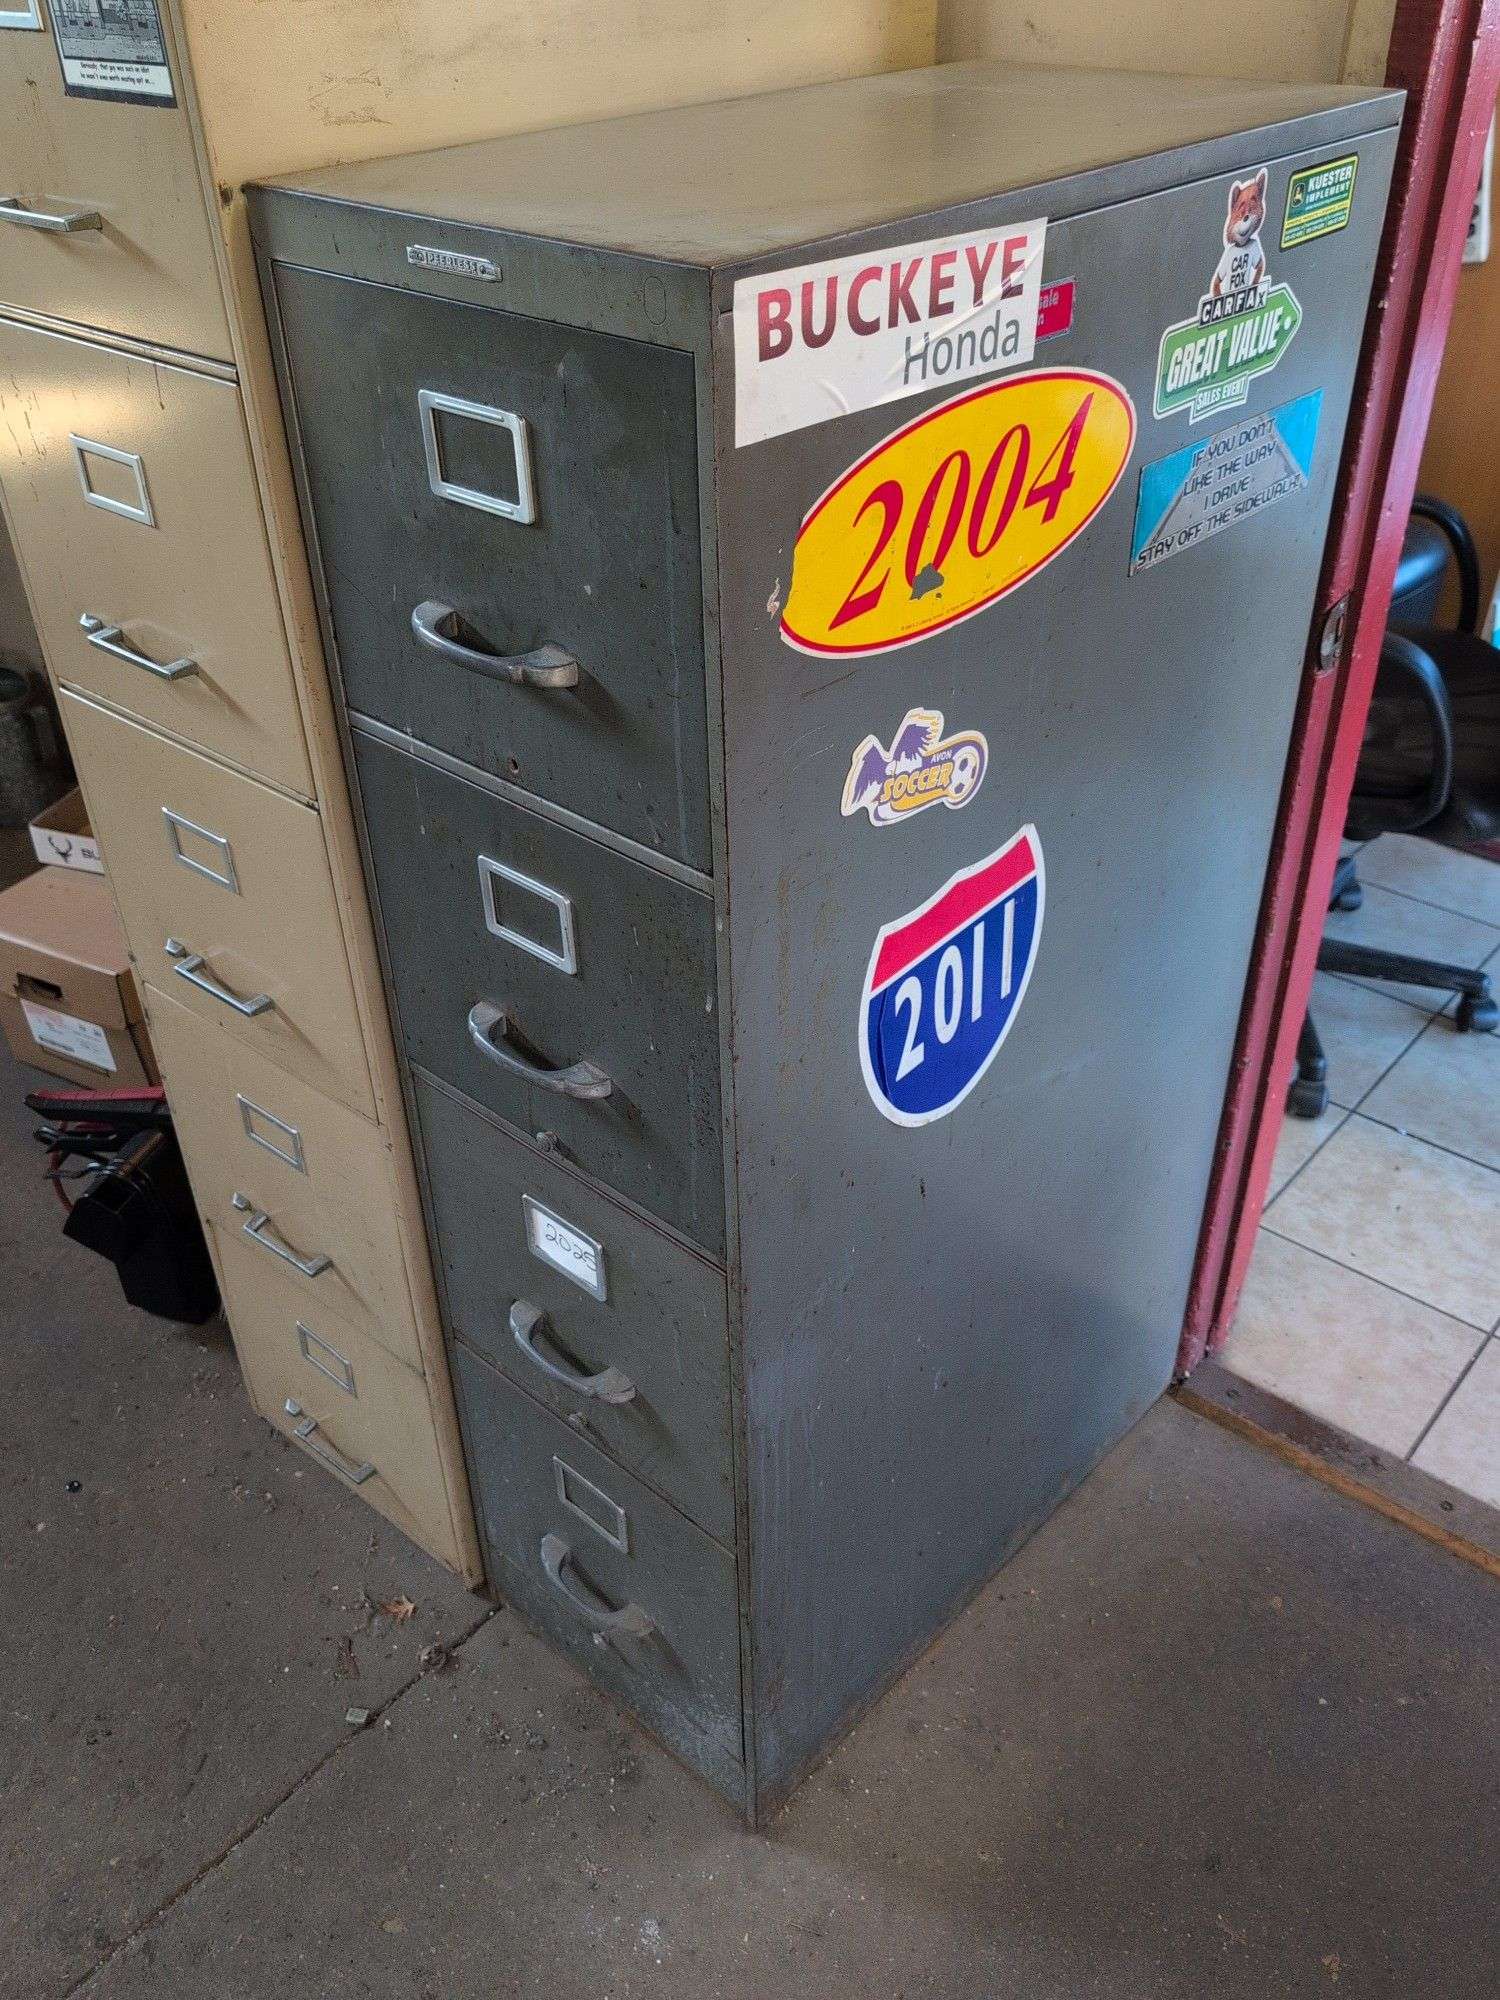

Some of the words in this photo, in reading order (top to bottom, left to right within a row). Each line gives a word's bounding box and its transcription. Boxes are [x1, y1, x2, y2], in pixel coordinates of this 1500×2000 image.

[1305, 181, 1350, 203] IMPLEMENT
[1308, 165, 1353, 193] KUESTER
[427, 251, 478, 275] PEERLESS
[1230, 270, 1246, 290] FOX
[1231, 253, 1249, 272] CAR
[757, 235, 1028, 363] BUCKEYE
[1202, 287, 1267, 323] CARFAX
[903, 309, 1020, 385] Honda
[1166, 329, 1228, 392] GREAT
[1227, 306, 1284, 367] VALUE
[1196, 387, 1222, 410] SALES
[1221, 380, 1246, 402] EVENT
[1182, 474, 1212, 497] LIKE
[1217, 460, 1242, 483] THE
[1244, 441, 1277, 467] WAY
[1191, 450, 1206, 468] IF
[1207, 438, 1235, 460] YOU
[828, 391, 1094, 631] 2004
[1203, 494, 1210, 510] I
[1211, 476, 1251, 507] DRIVE
[1137, 537, 1175, 567] STAY
[1177, 521, 1203, 546] OFF
[1206, 508, 1232, 532] THE
[930, 750, 953, 764] AVON
[879, 762, 954, 803] SOCCER
[894, 898, 1016, 1082] 2011
[545, 1223, 597, 1271] 2025
